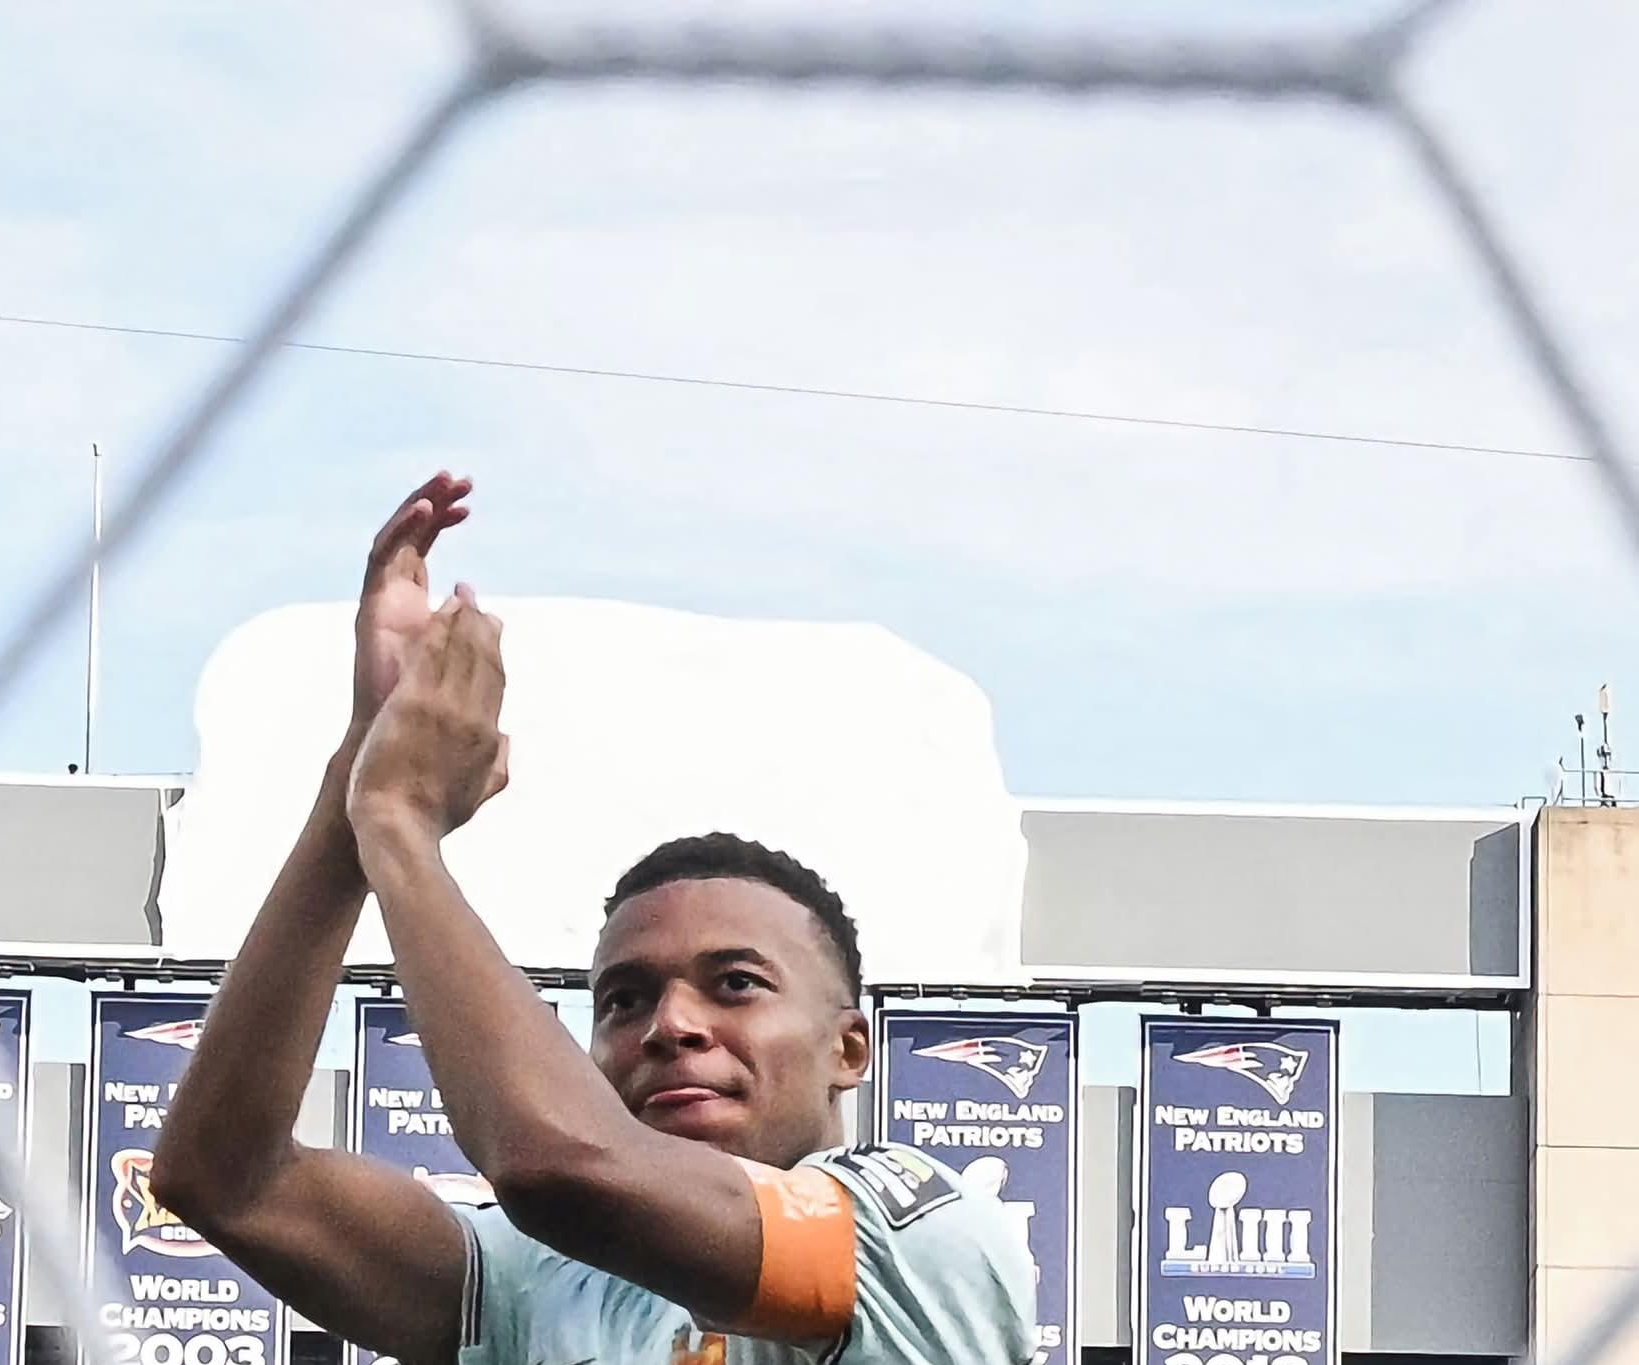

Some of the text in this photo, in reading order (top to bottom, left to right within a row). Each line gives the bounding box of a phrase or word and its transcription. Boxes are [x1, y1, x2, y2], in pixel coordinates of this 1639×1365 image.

[104, 1082, 160, 1104] NEW
[368, 1087, 424, 1110] NEW
[893, 1099, 1064, 1125] NEW ENGLAND
[1155, 1105, 1325, 1129] NEW ENGLAND
[913, 1121, 1044, 1149] PATRIOTS
[1174, 1127, 1305, 1154] PATRIOTS
[129, 1274, 240, 1303] WORLD
[100, 1302, 270, 1332] CHAMPIONS
[1183, 1296, 1291, 1324] WORLD
[1152, 1324, 1322, 1354] CHAMPIONS
